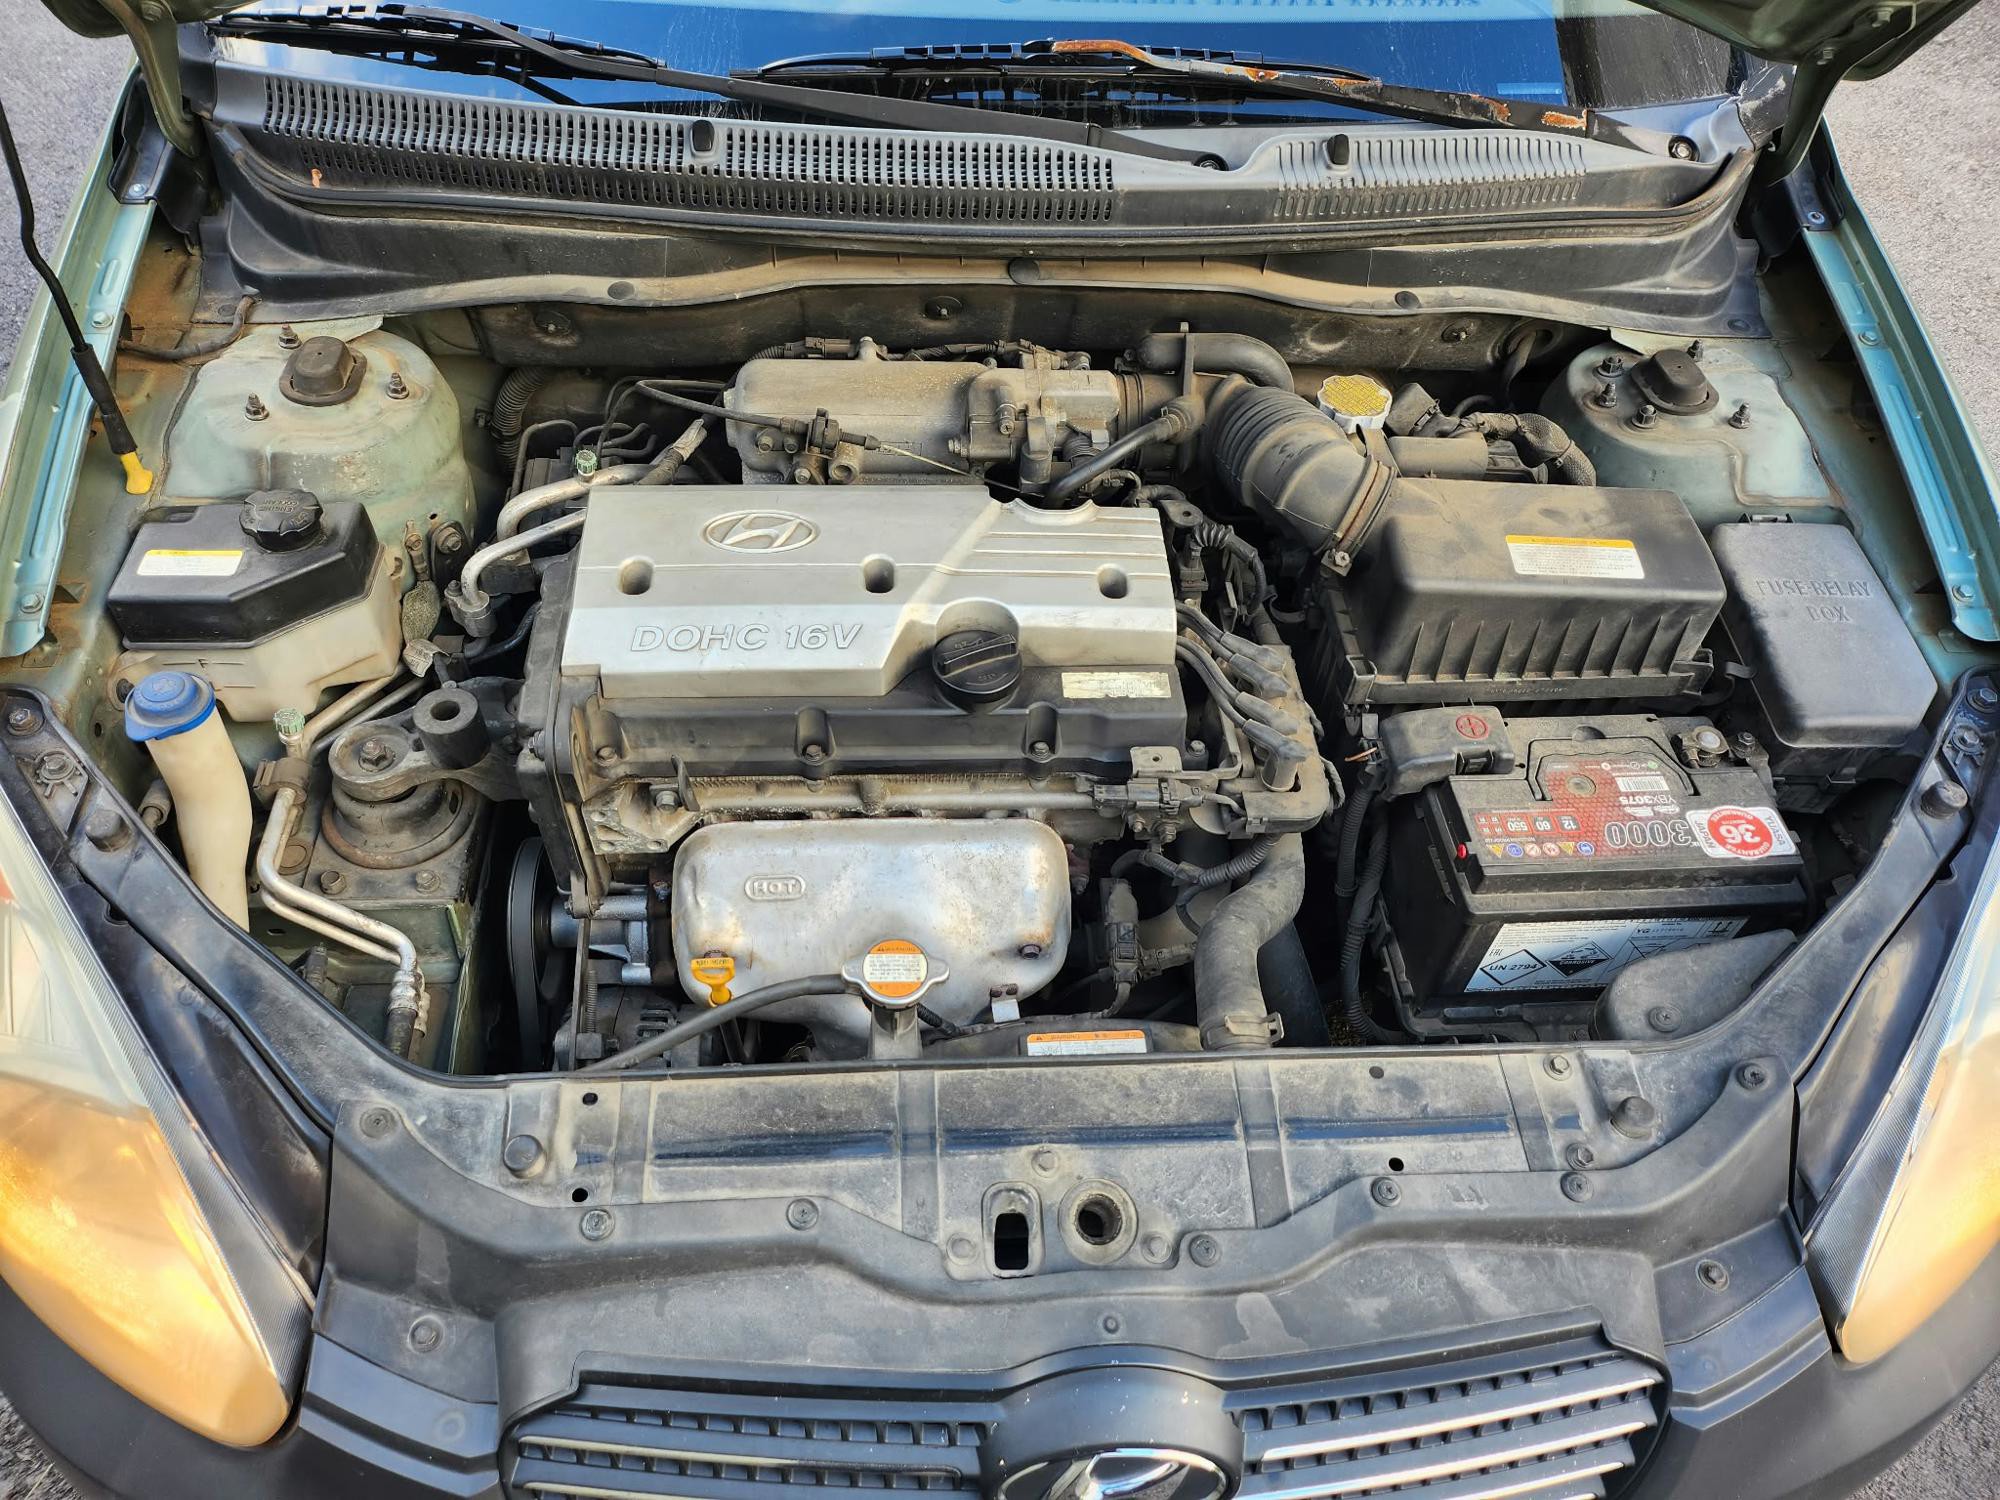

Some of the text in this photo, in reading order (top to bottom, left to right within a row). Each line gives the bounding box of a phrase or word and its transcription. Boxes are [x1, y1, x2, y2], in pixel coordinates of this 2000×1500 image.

[631, 624, 863, 651] DOHC 16V
[1619, 794, 1677, 805] YBX3075
[1507, 820, 1528, 831] 550
[1535, 820, 1551, 831] 60
[1564, 819, 1577, 830] 12
[1765, 815, 1787, 846] YUASA
[1605, 820, 1691, 848] 3000
[1694, 820, 1715, 848] JAPAN
[1719, 823, 1760, 844] 36
[753, 880, 796, 896] HOT
[1509, 963, 1538, 971] 2794
